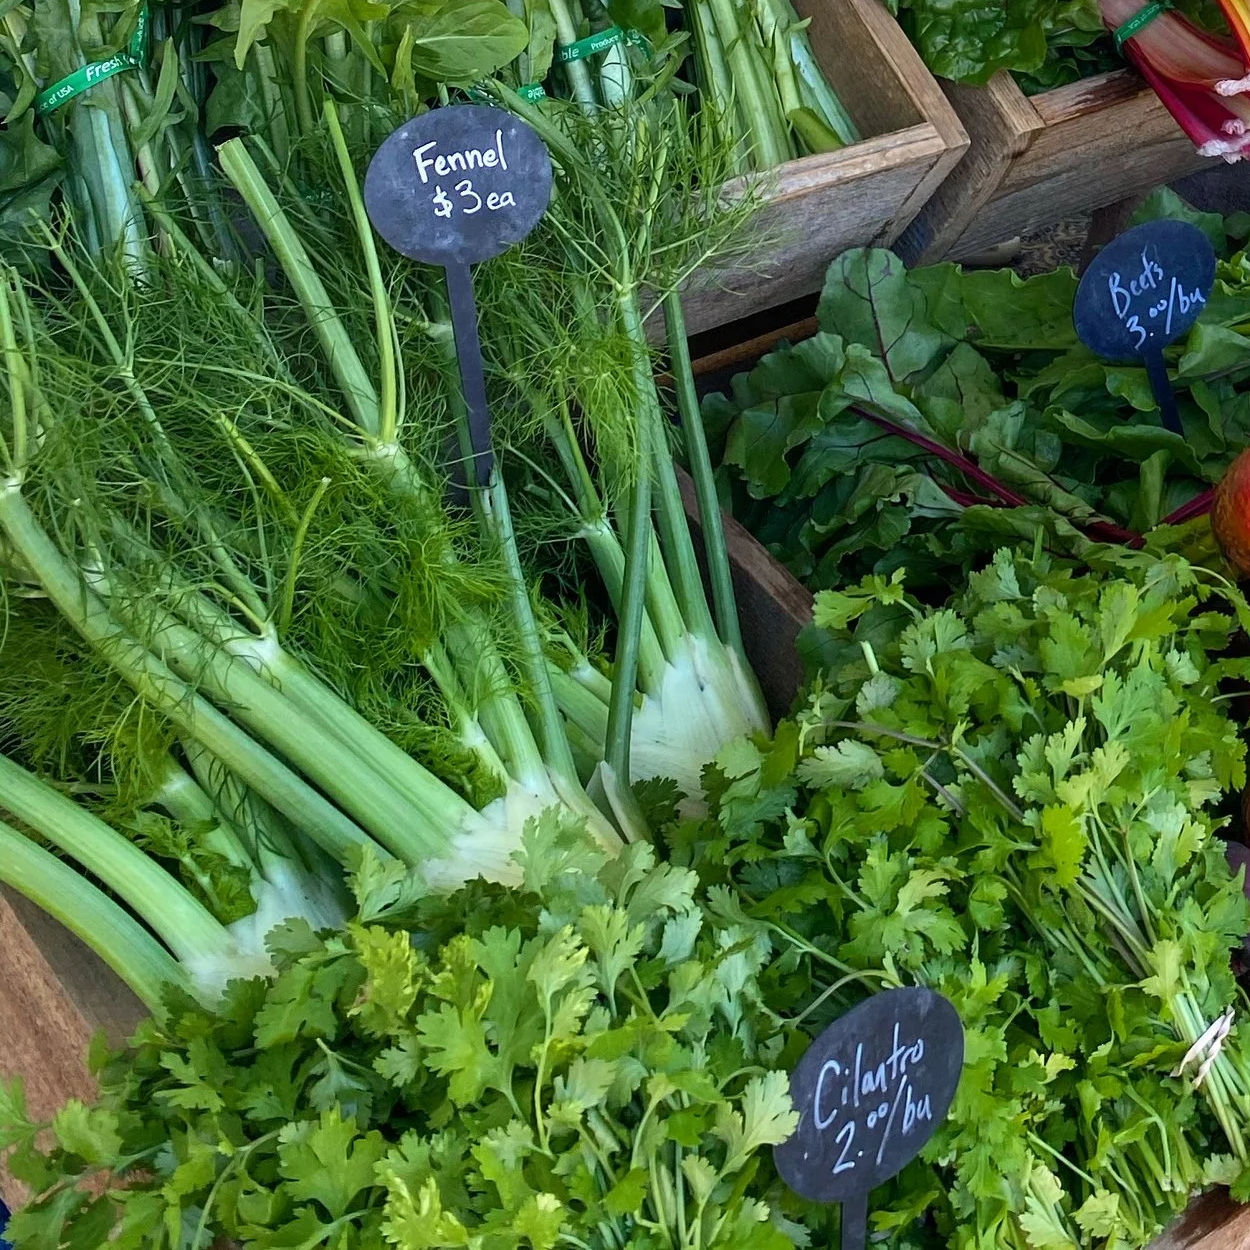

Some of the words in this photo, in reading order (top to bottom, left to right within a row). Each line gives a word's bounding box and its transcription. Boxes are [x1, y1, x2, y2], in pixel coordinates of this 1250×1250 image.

[57, 84, 75, 99] USA
[85, 55, 123, 82] Fresh
[412, 129, 508, 184] Fennel
[1108, 248, 1164, 319] Beets
[814, 1021, 925, 1130] Cilantro
